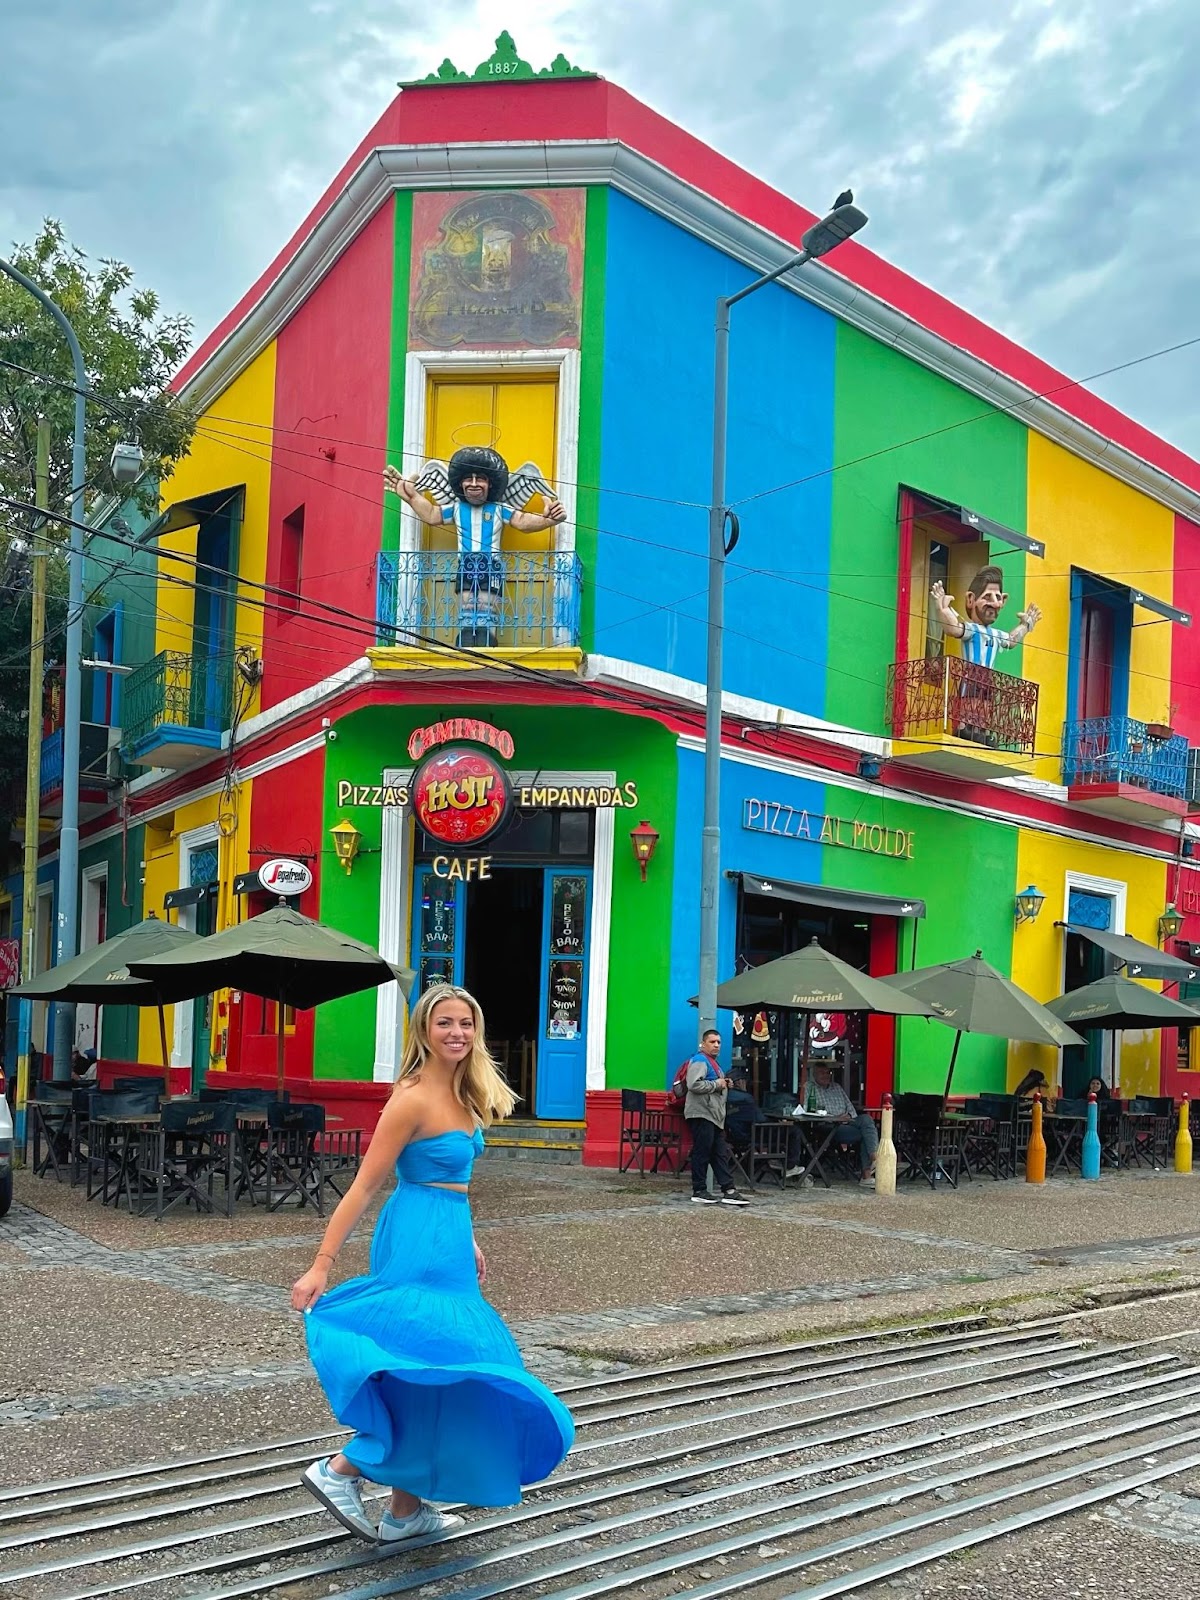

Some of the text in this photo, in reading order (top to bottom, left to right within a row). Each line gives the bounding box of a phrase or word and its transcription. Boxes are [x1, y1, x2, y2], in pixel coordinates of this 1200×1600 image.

[488, 62, 519, 75] 1887
[407, 718, 515, 760] CAMINITO
[338, 781, 638, 808] PIZZAS EMPANADAS
[748, 798, 916, 859] PIZZA AL MOLDE
[432, 855, 493, 881] CAFE
[434, 900, 444, 932] RESTO
[563, 903, 572, 935] RESTO
[426, 932, 449, 942] BAR
[556, 936, 580, 947] BAR
[551, 999, 576, 1010] SHOW
[791, 992, 844, 1005] Imperial
